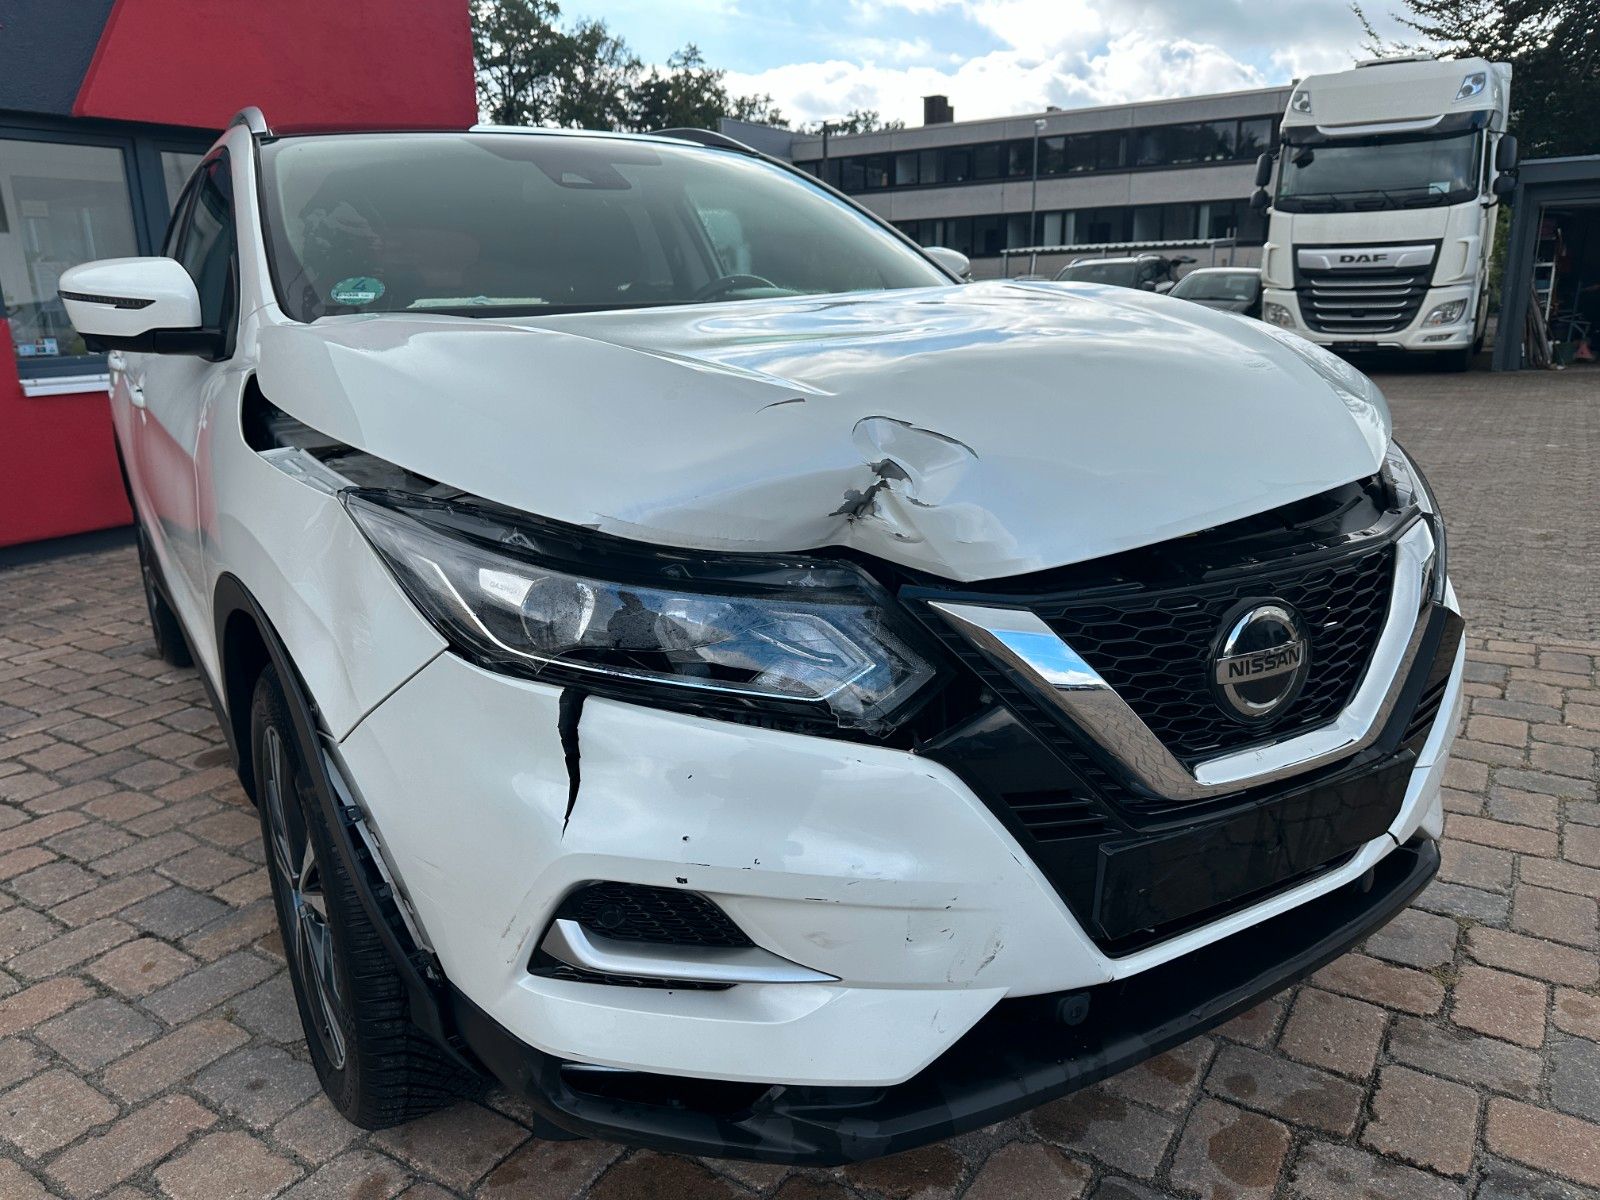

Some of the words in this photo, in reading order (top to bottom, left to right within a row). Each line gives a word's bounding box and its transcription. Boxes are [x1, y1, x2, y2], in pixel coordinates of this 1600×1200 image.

[1339, 253, 1388, 264] DAF
[351, 279, 367, 292] 4
[1228, 647, 1300, 678] NISSAN
